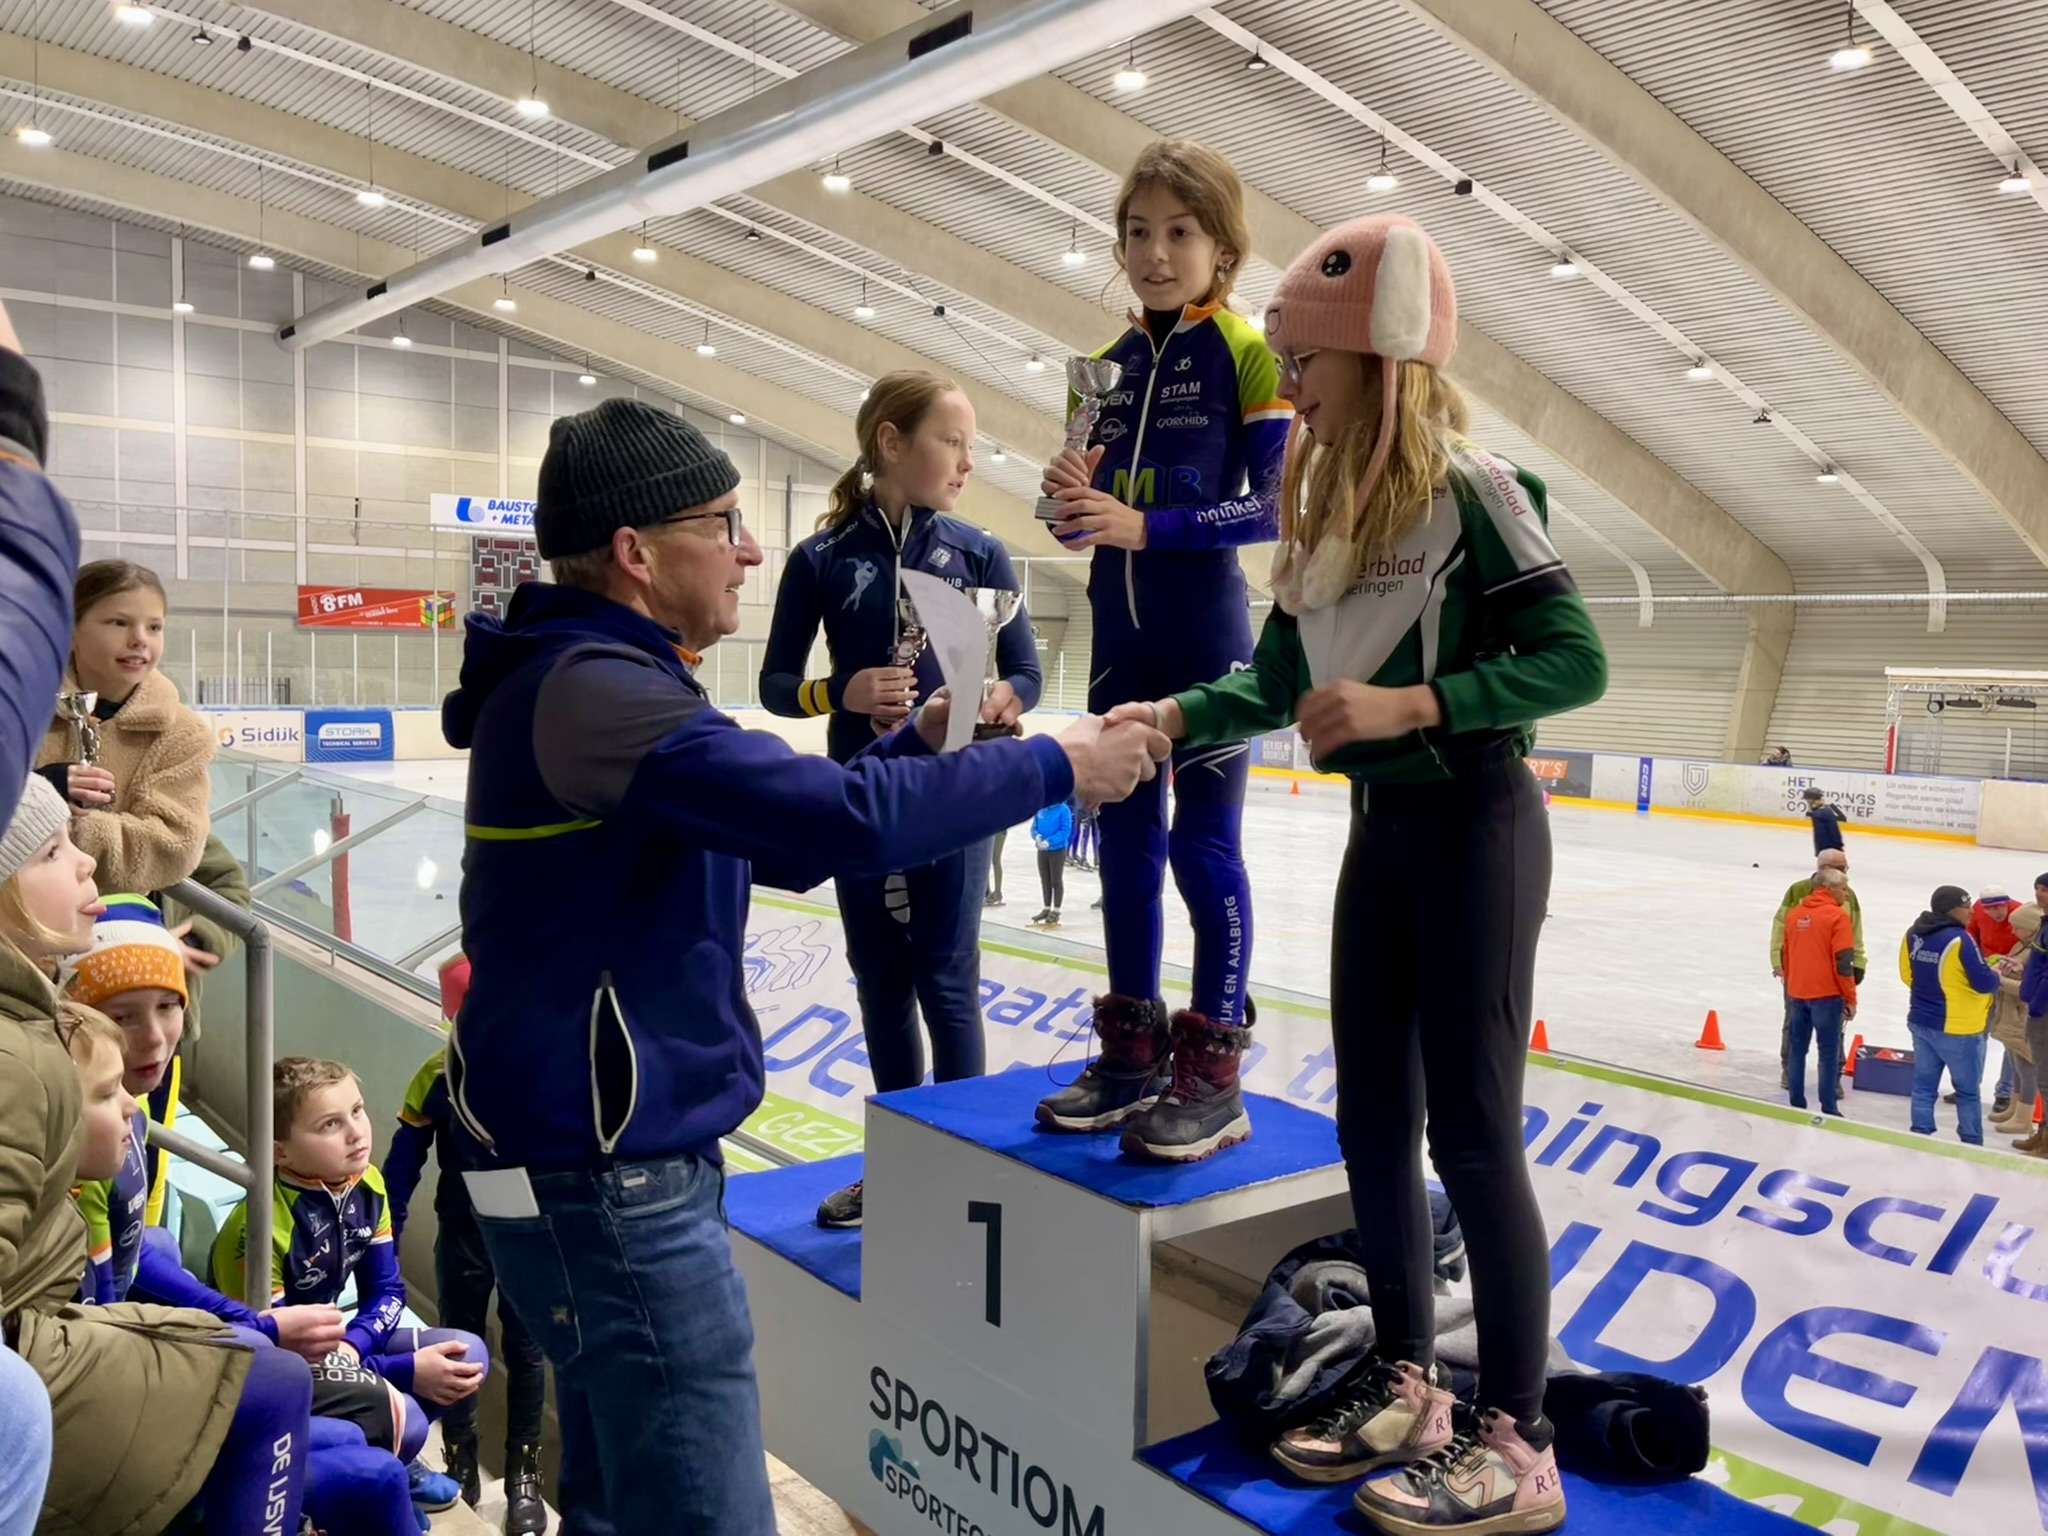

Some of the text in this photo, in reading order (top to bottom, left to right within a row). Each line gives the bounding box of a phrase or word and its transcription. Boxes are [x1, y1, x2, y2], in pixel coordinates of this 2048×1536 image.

[1160, 381, 1200, 398] STAM
[1346, 579, 1404, 597] eringen
[241, 727, 299, 742] Sidijk
[325, 727, 372, 736] STORK
[1787, 776, 1815, 788] HET
[1225, 896, 1242, 967] AALBURG
[1224, 974, 1238, 994] EN
[1219, 1000, 1234, 1025] IJK
[968, 1200, 1002, 1328] 1
[869, 1366, 1106, 1536] SPORTIOM
